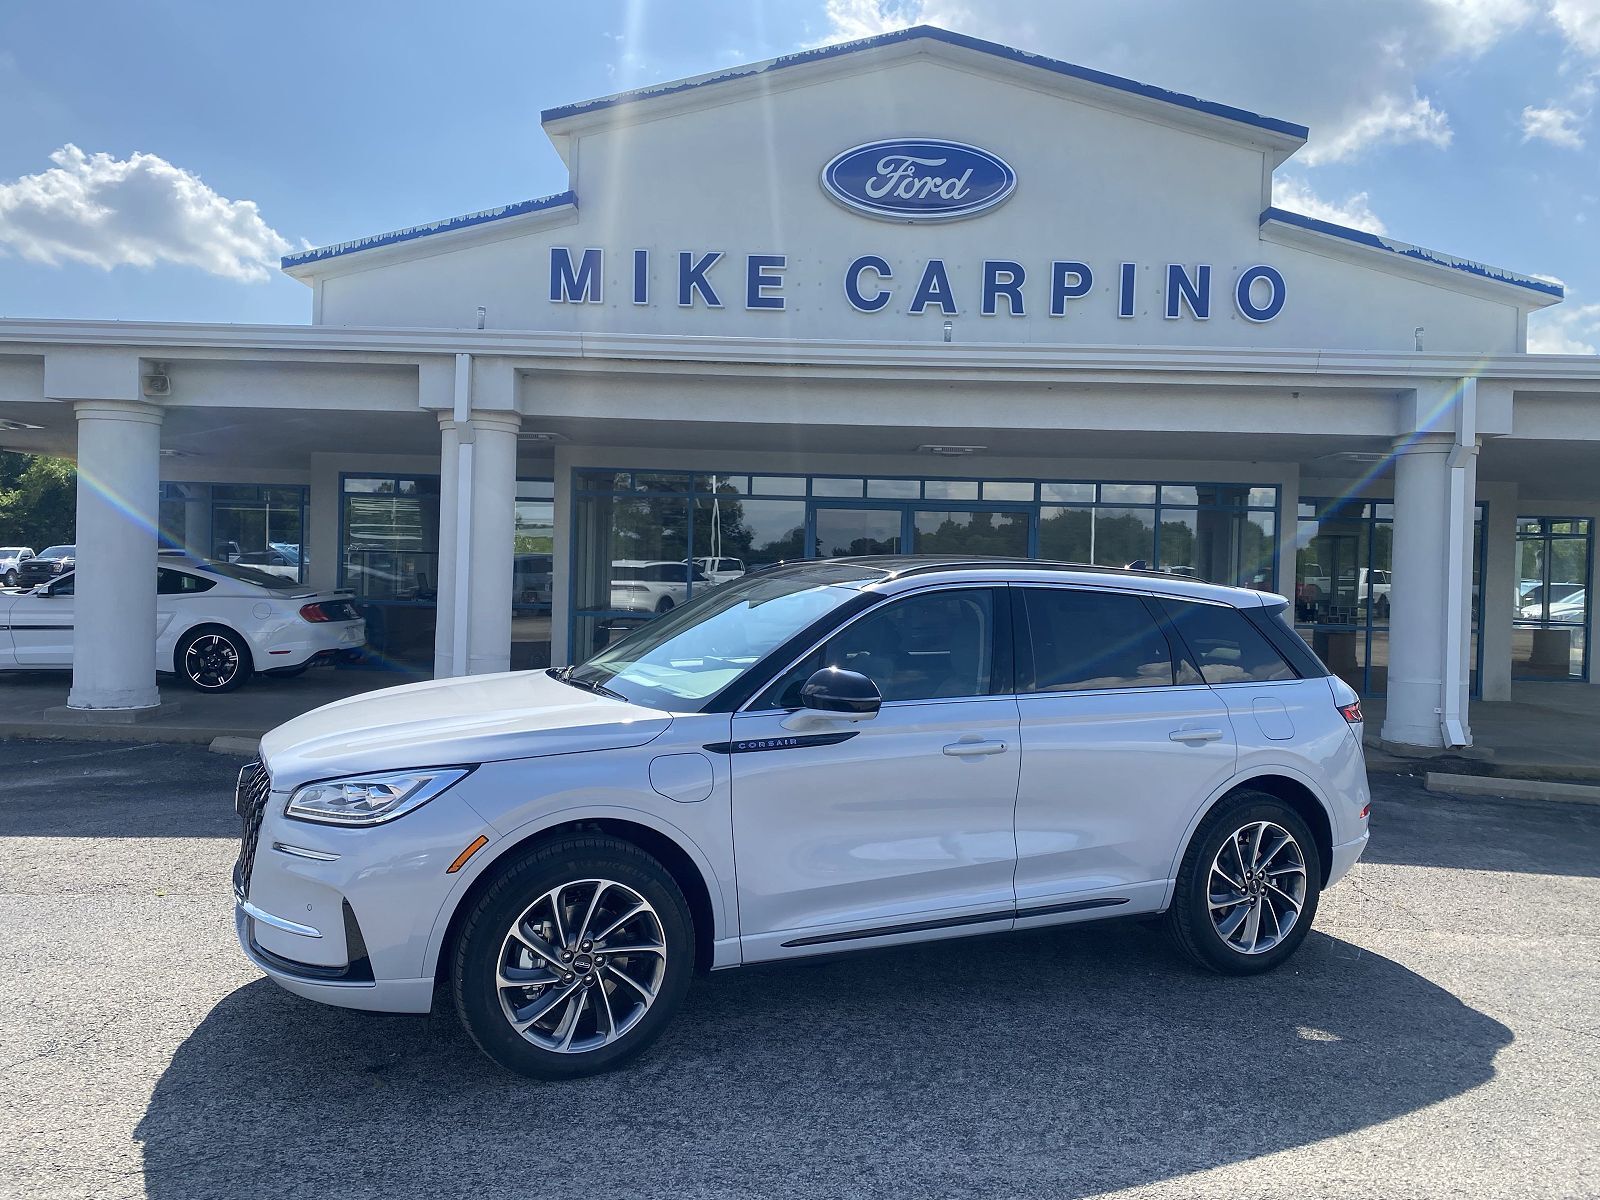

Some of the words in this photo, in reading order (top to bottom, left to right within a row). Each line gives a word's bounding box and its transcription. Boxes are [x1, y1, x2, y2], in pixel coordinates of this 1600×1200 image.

[865, 155, 973, 199] Ford
[549, 246, 787, 311] MIKE
[843, 254, 1288, 323] CARPINO
[738, 738, 797, 749] CORSAIR
